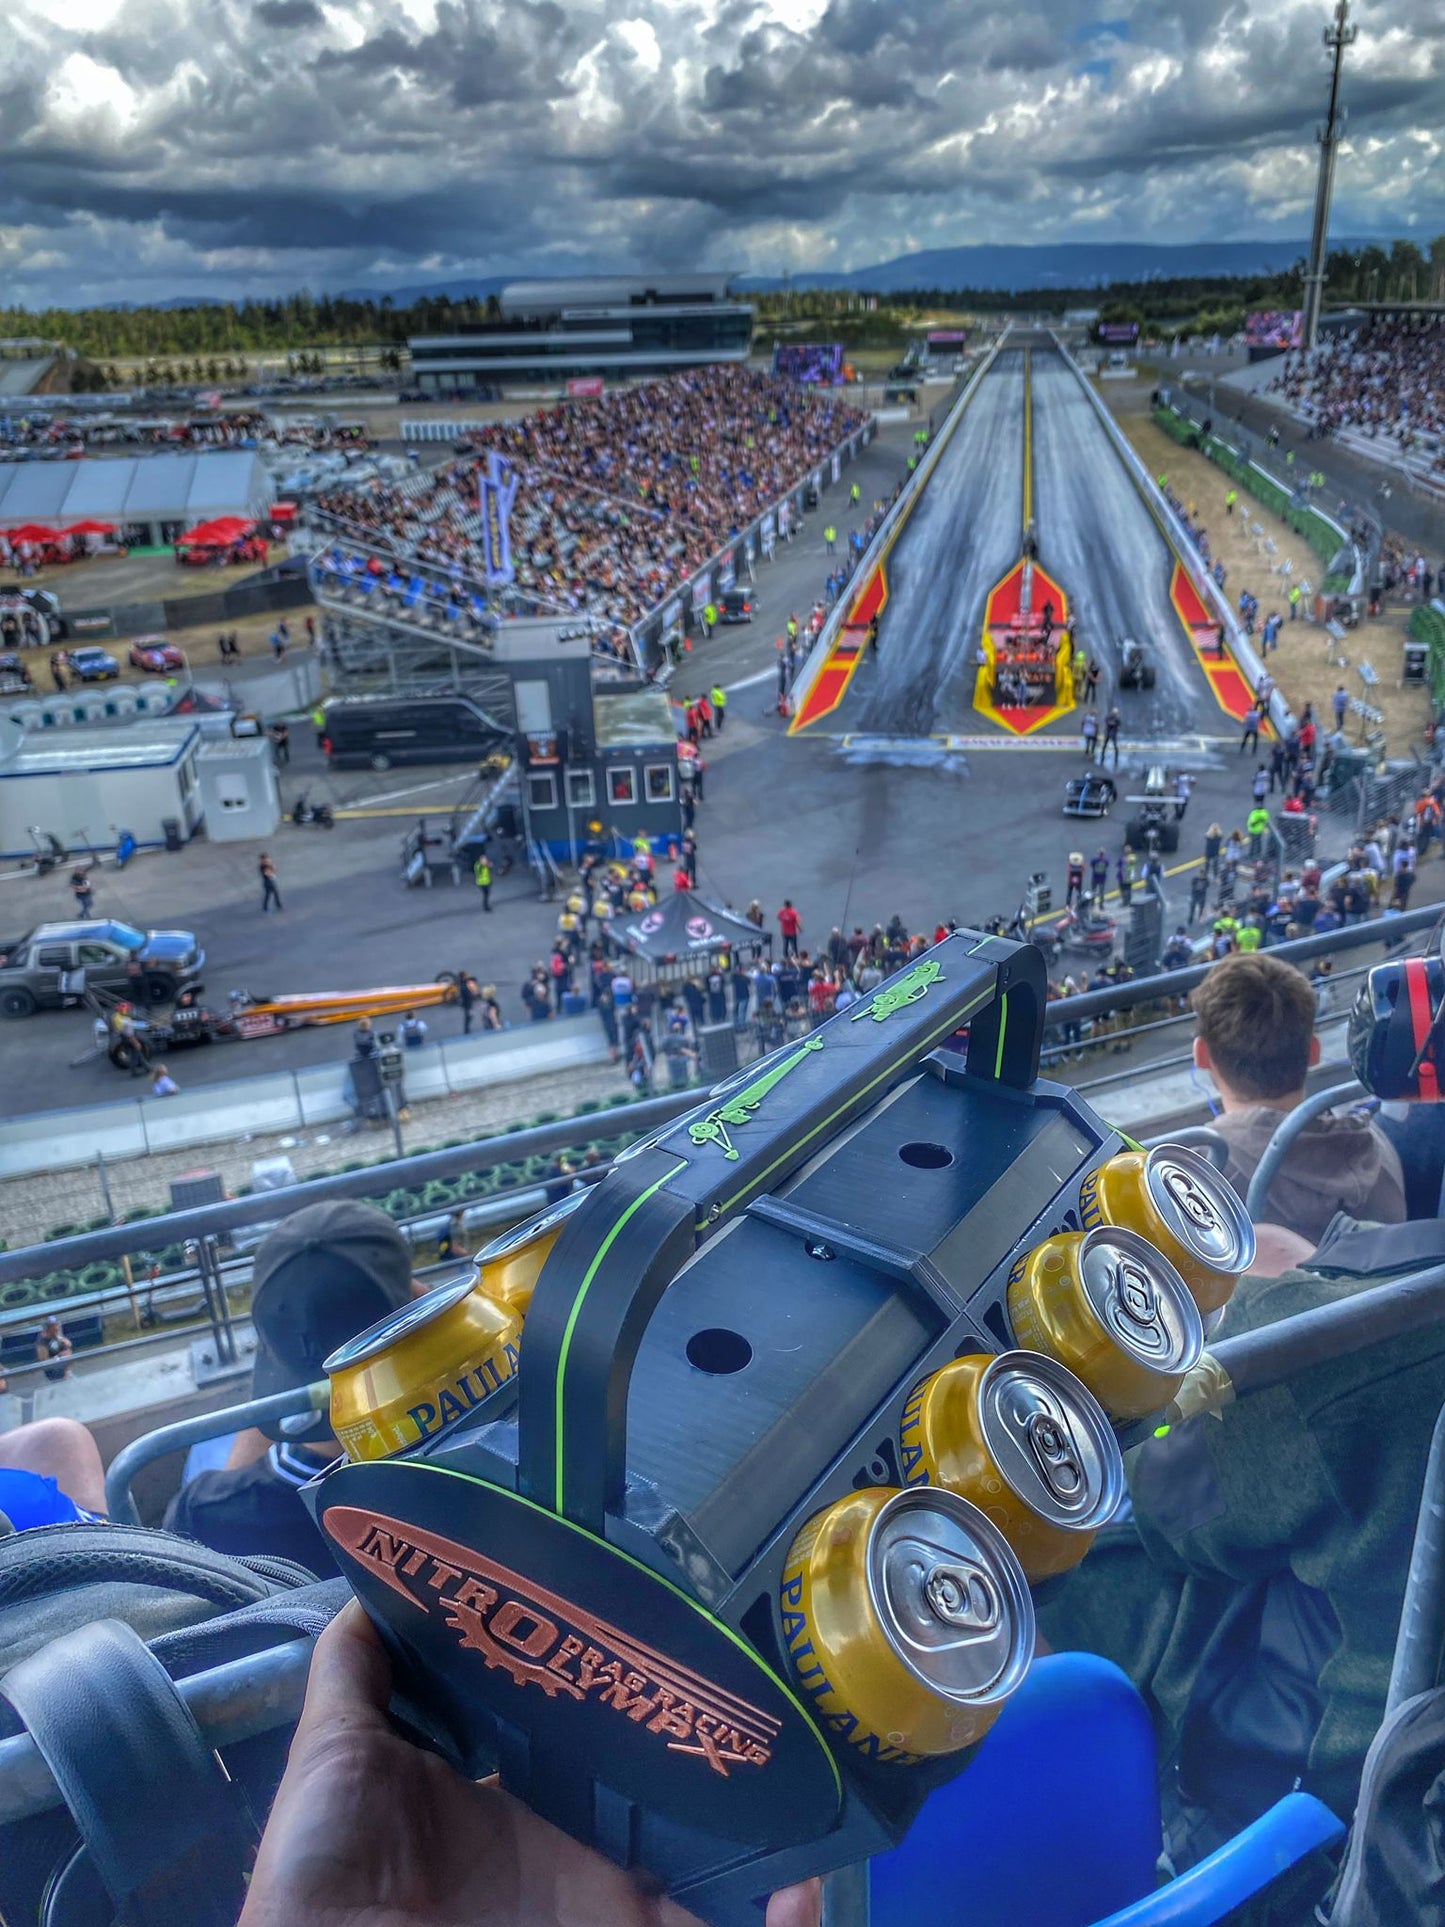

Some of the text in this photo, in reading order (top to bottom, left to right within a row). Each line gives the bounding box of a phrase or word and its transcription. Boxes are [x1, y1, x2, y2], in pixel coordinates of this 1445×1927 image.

[407, 1337, 521, 1438] PAULA
[560, 1634, 773, 1766] DRAG RACING
